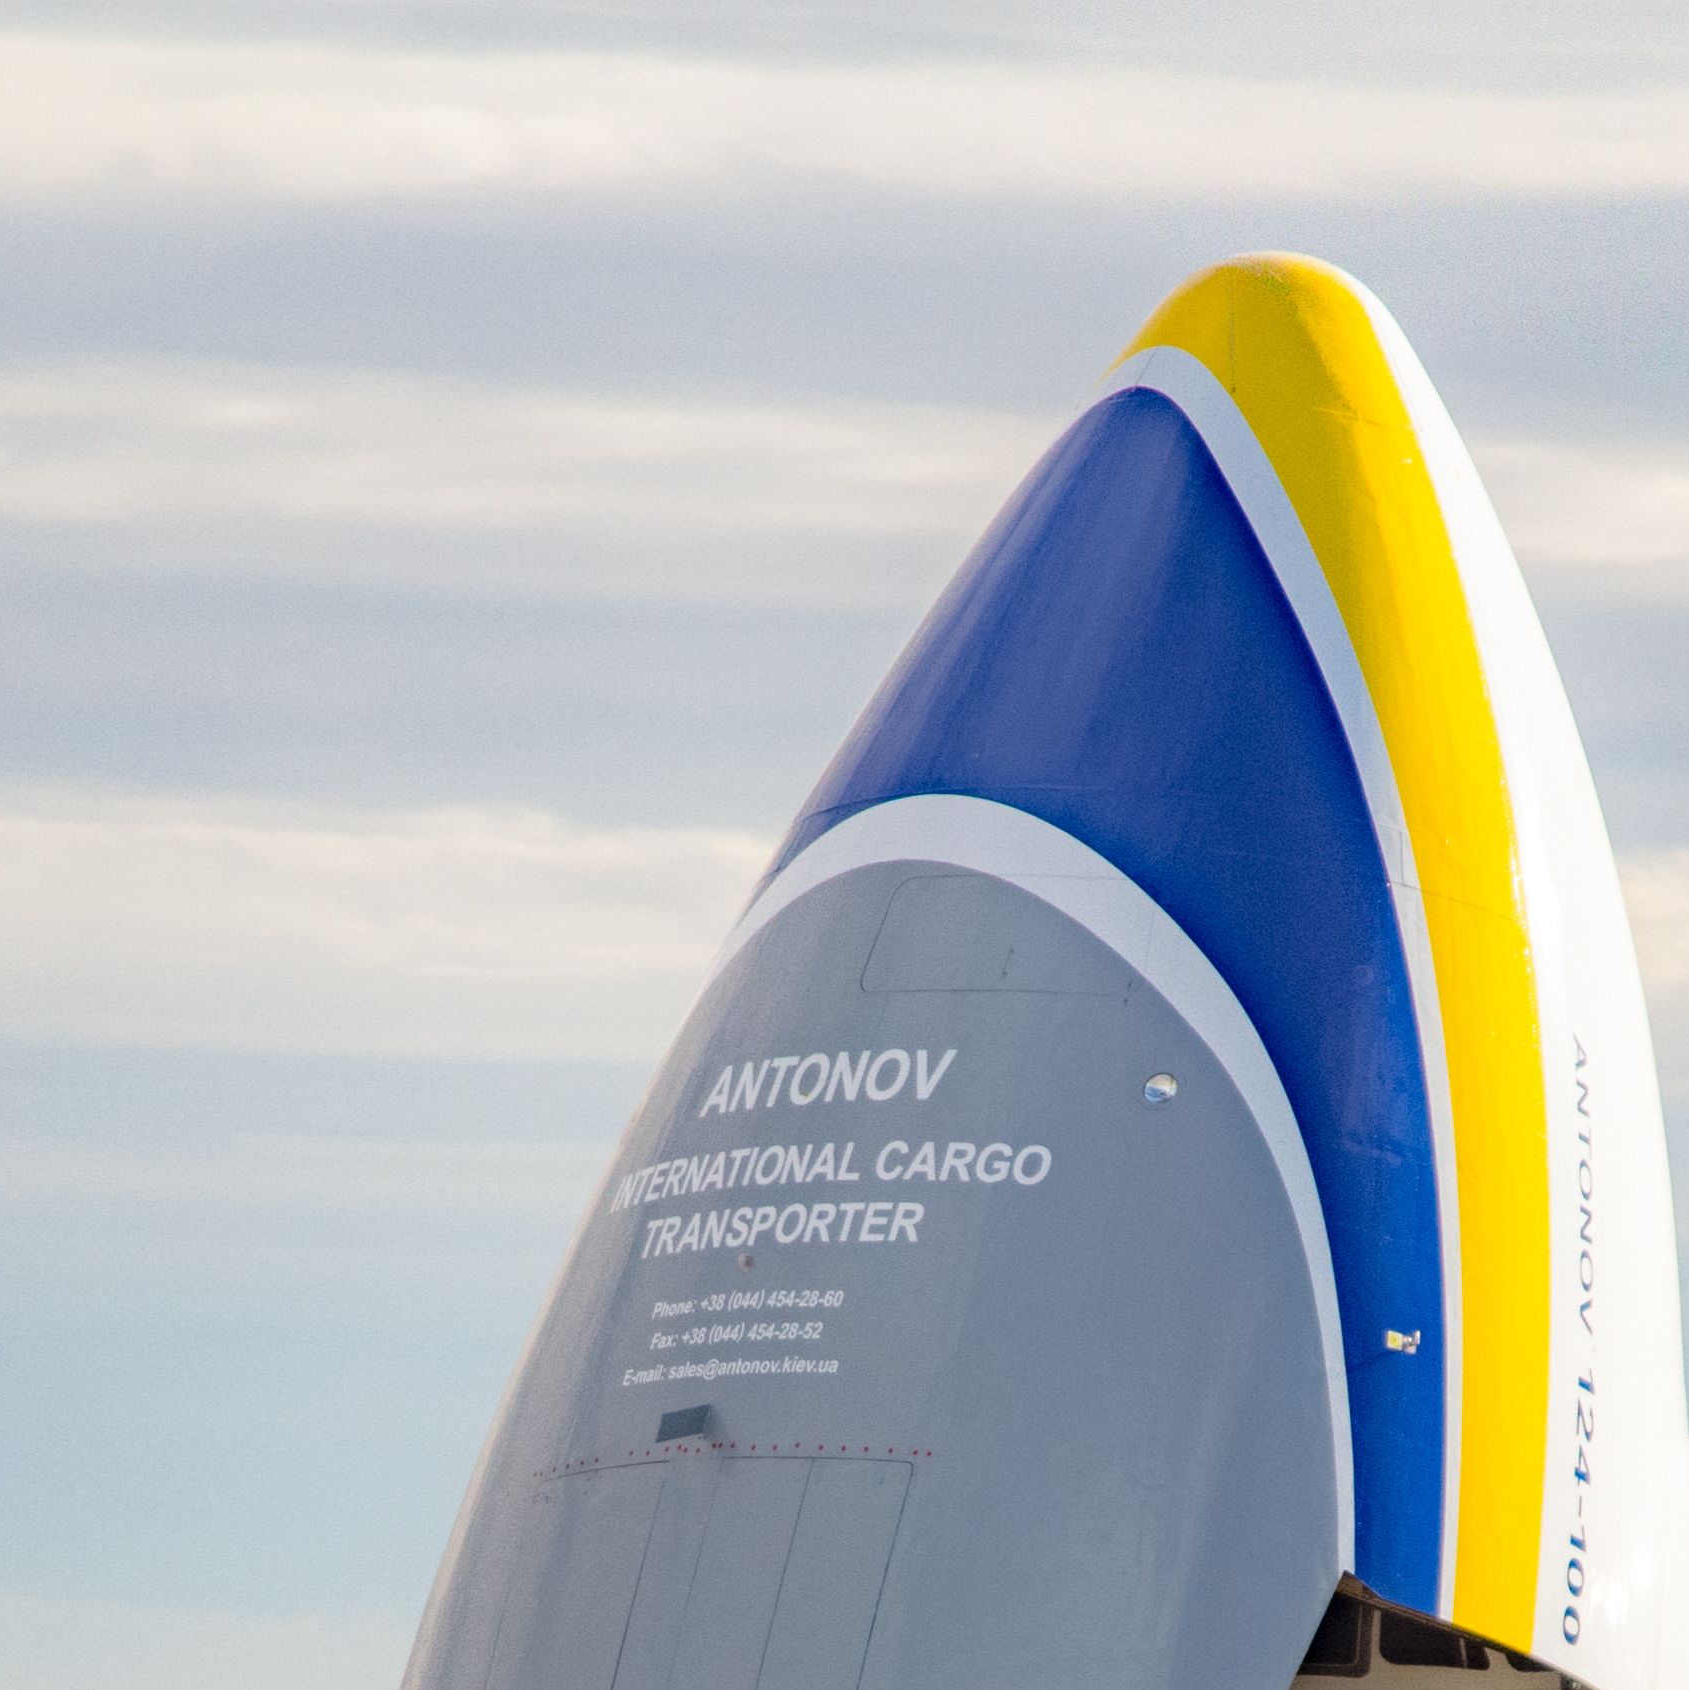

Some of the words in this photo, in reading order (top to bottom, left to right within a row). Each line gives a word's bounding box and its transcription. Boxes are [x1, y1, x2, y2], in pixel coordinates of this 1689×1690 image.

[699, 1048, 958, 1118] ANTONOV
[610, 1143, 861, 1214] INTERNATIONAL
[874, 1142, 1053, 1186] CARGO
[1571, 1032, 1595, 1336] ANTONOV
[640, 1201, 926, 1259] TRANSPORTER
[651, 1299, 697, 1319] Phone:
[700, 1294, 726, 1312] +38
[728, 1290, 765, 1312] (044)
[767, 1289, 843, 1308] 454-28-60
[650, 1332, 678, 1351] Fax:
[681, 1327, 707, 1345] +38
[708, 1324, 745, 1345] (044)
[747, 1323, 823, 1340] 454-28-52
[622, 1365, 666, 1387] E-mail:
[668, 1355, 839, 1382] sales@antonov.kiev.ua
[1561, 1367, 1595, 1647] 124-100
